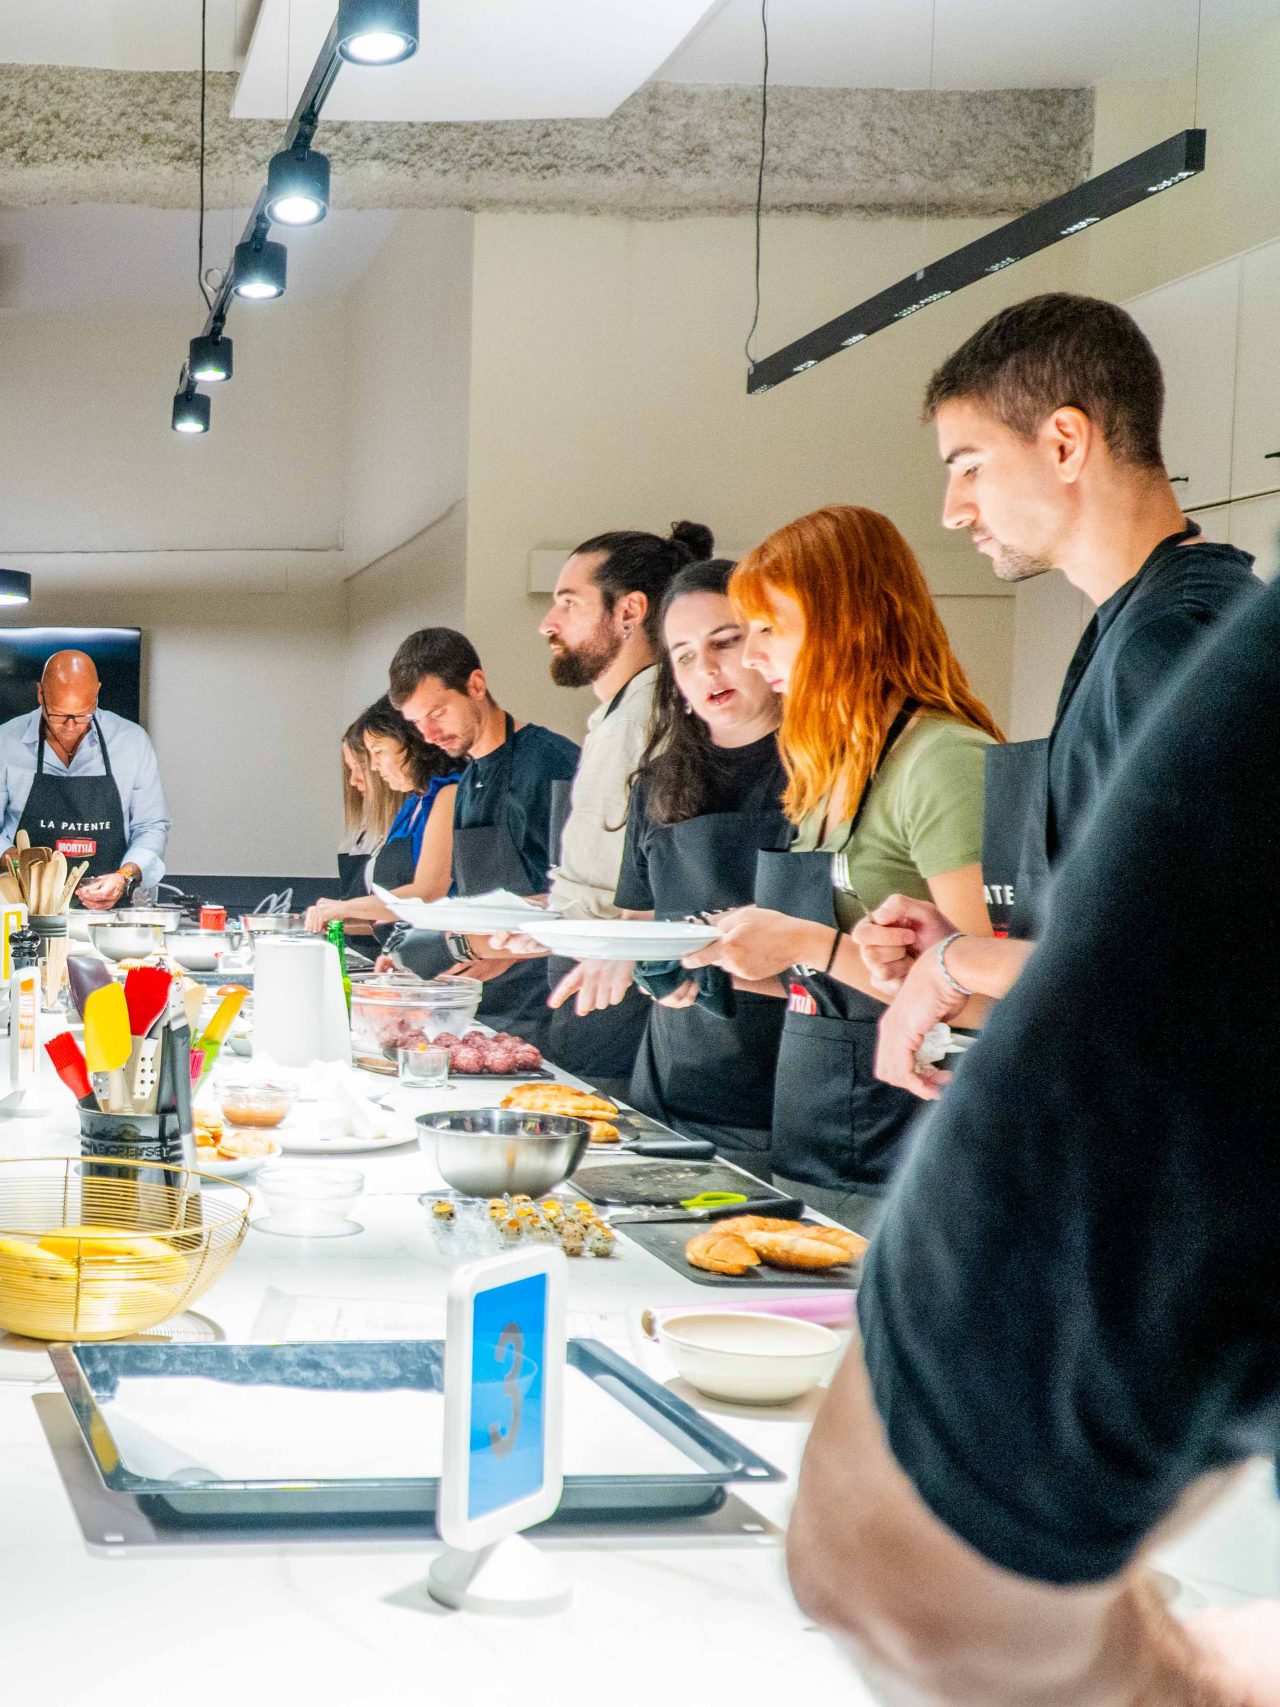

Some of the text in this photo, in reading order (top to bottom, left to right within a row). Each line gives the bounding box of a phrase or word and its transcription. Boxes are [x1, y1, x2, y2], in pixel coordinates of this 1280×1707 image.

[40, 819, 111, 832] LA PATENTE
[489, 1321, 524, 1461] 3
